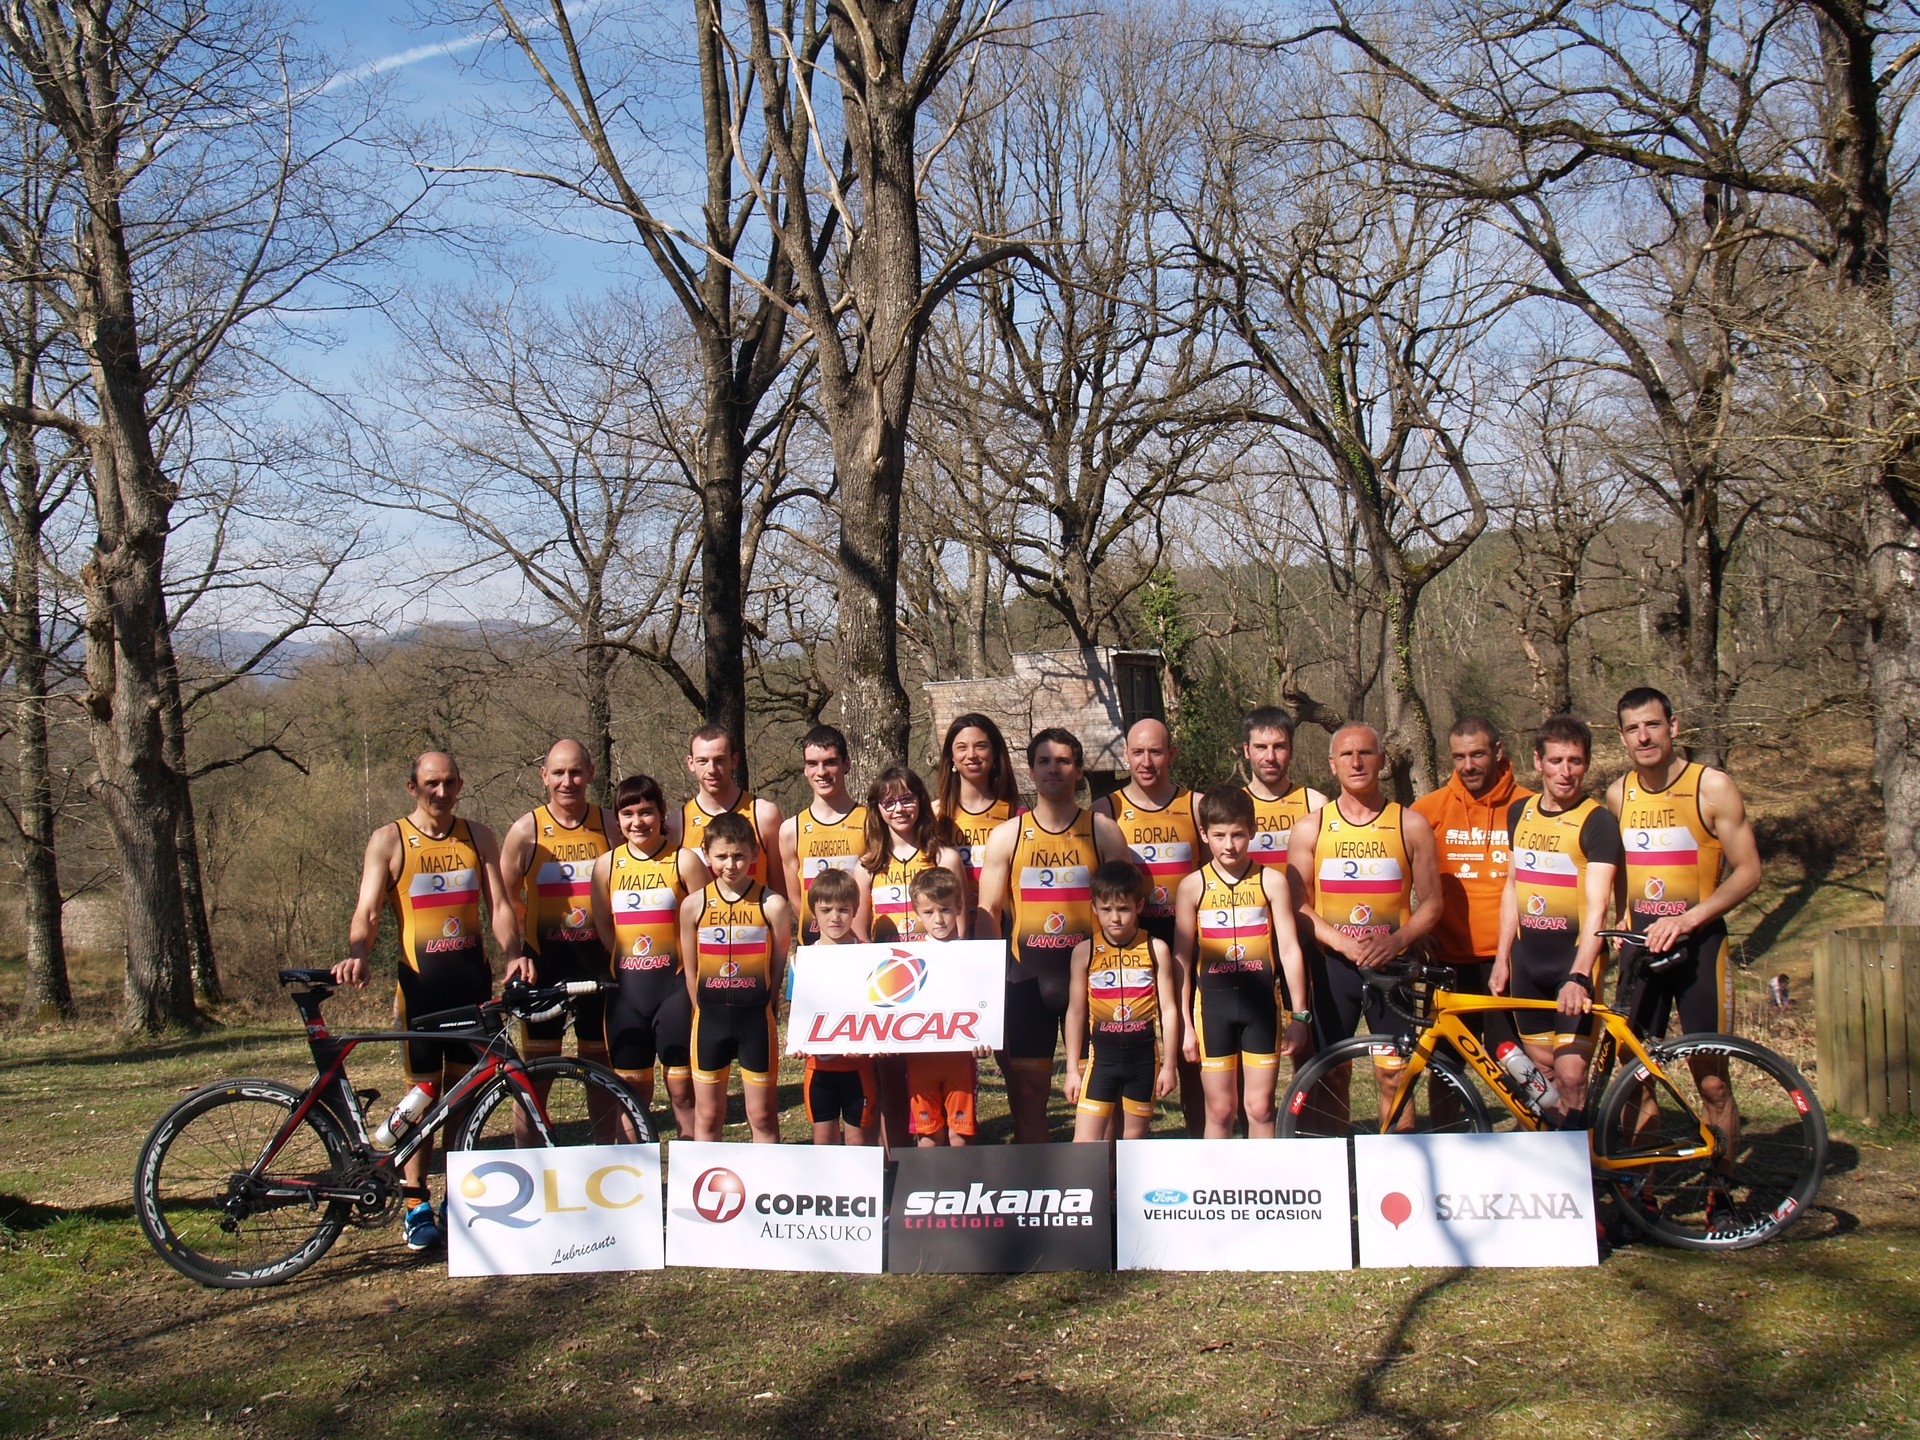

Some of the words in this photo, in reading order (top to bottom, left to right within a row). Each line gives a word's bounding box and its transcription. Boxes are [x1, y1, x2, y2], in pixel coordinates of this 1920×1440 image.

[1640, 809, 1676, 829] EULATE
[1134, 826, 1180, 843] BORJA
[1446, 827, 1509, 840] sakan
[1637, 831, 1672, 850] QLC
[809, 839, 850, 856] AZKARGORTA
[1335, 841, 1388, 858] VERGARA
[1529, 833, 1560, 852] GOMEZ
[551, 841, 600, 862] AZURMENDI
[1030, 849, 1080, 867] IÑAKI
[1142, 845, 1176, 862] QLC
[1491, 850, 1509, 863] QL
[420, 854, 467, 873] MAIZA
[1343, 861, 1382, 879] QLC
[431, 875, 466, 892] QLC
[618, 873, 668, 891] MAIZA
[1039, 869, 1076, 887] QLC
[627, 892, 664, 909] QLC
[1211, 891, 1256, 908] A.RAZKIN
[1634, 900, 1687, 915] LANCAR
[709, 911, 753, 925] EKAIN
[546, 927, 600, 942] LANCA
[1027, 933, 1084, 948] LANCAR
[425, 937, 476, 953] LANCAR
[619, 955, 670, 970] LANCAR
[1100, 954, 1141, 969] AITOR
[1209, 960, 1263, 974] LANCAR
[705, 977, 756, 988] LANCAR
[806, 1010, 979, 1043] LANCAR
[1100, 1020, 1147, 1033] LANCAR
[589, 1072, 651, 1144] COSMI
[460, 1161, 645, 1229] QLC
[904, 1183, 1094, 1215] sakana
[1152, 1190, 1181, 1203] Ford
[1192, 1189, 1322, 1205] GABIRONDO
[755, 1193, 876, 1218] COPRECI
[1436, 1193, 1583, 1221] SAKANA
[904, 1215, 1005, 1229] triatloia
[1017, 1213, 1093, 1227] taldea
[1143, 1209, 1225, 1220] VEHICULOS
[1231, 1209, 1250, 1220] DE
[1255, 1209, 1322, 1220] OCASION
[760, 1221, 872, 1242] ALTSASUKO
[551, 1235, 617, 1265] Lubricants
